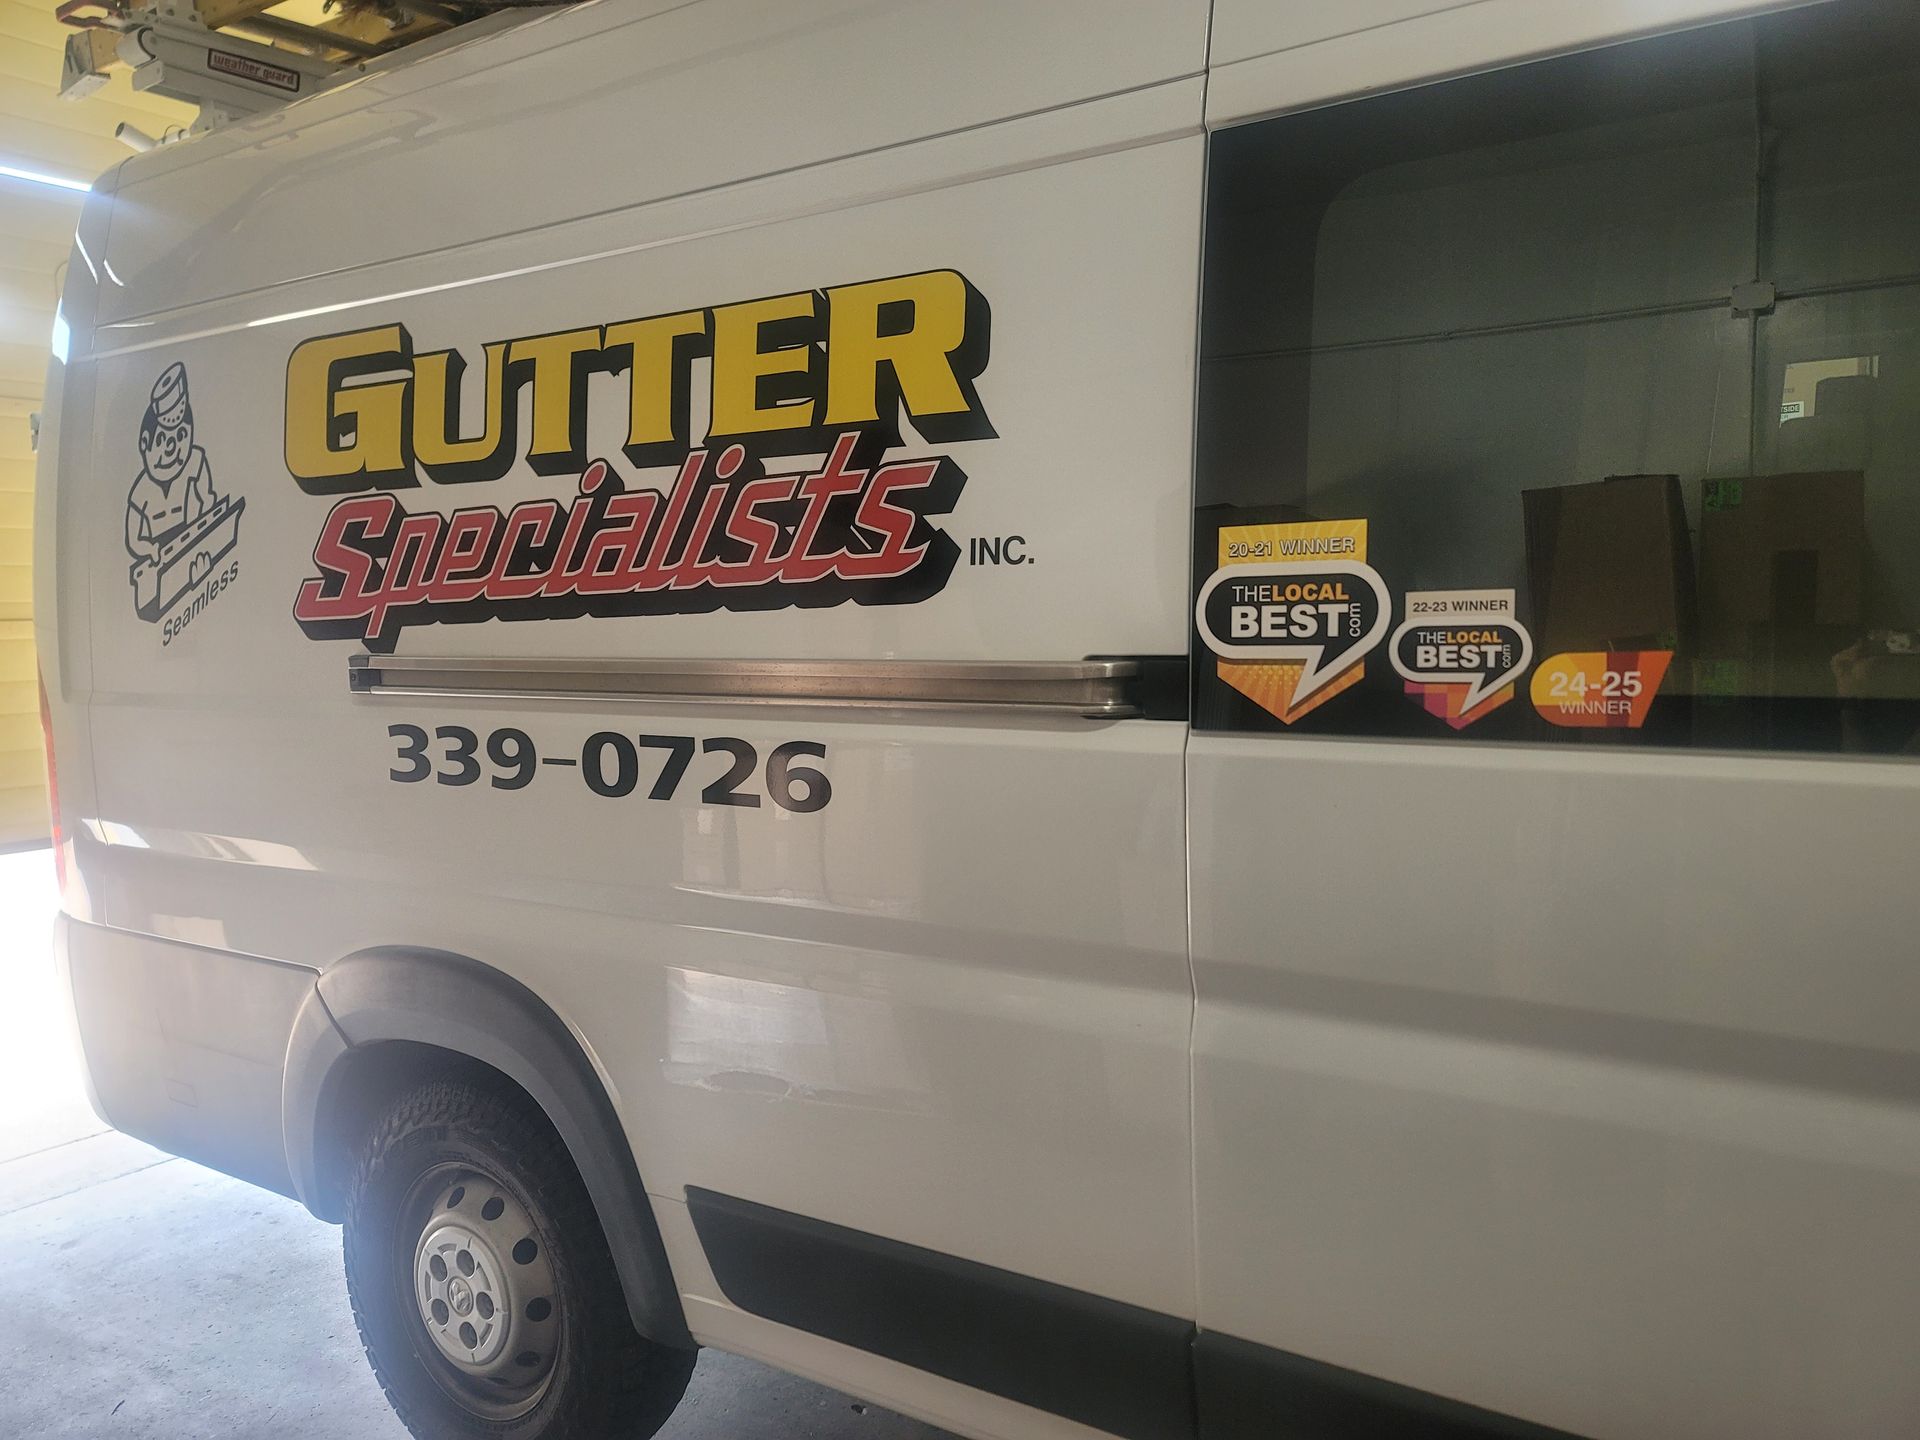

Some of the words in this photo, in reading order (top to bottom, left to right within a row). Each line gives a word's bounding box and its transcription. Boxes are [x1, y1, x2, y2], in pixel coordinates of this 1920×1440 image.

[214, 54, 260, 75] weather
[262, 68, 294, 84] guard
[292, 430, 968, 654] Specialists
[969, 536, 1035, 566] INC.
[1229, 541, 1273, 557] 20-21
[1279, 537, 1355, 555] WINNER
[162, 560, 239, 646] Seamless
[1412, 602, 1448, 612] 22-23
[1451, 600, 1508, 612] WINNER
[1230, 602, 1350, 638] BEST
[1416, 644, 1503, 669] BEST
[1549, 671, 1643, 698] 24-25
[1558, 700, 1632, 716] WINNER
[386, 723, 832, 813] 339-0726
